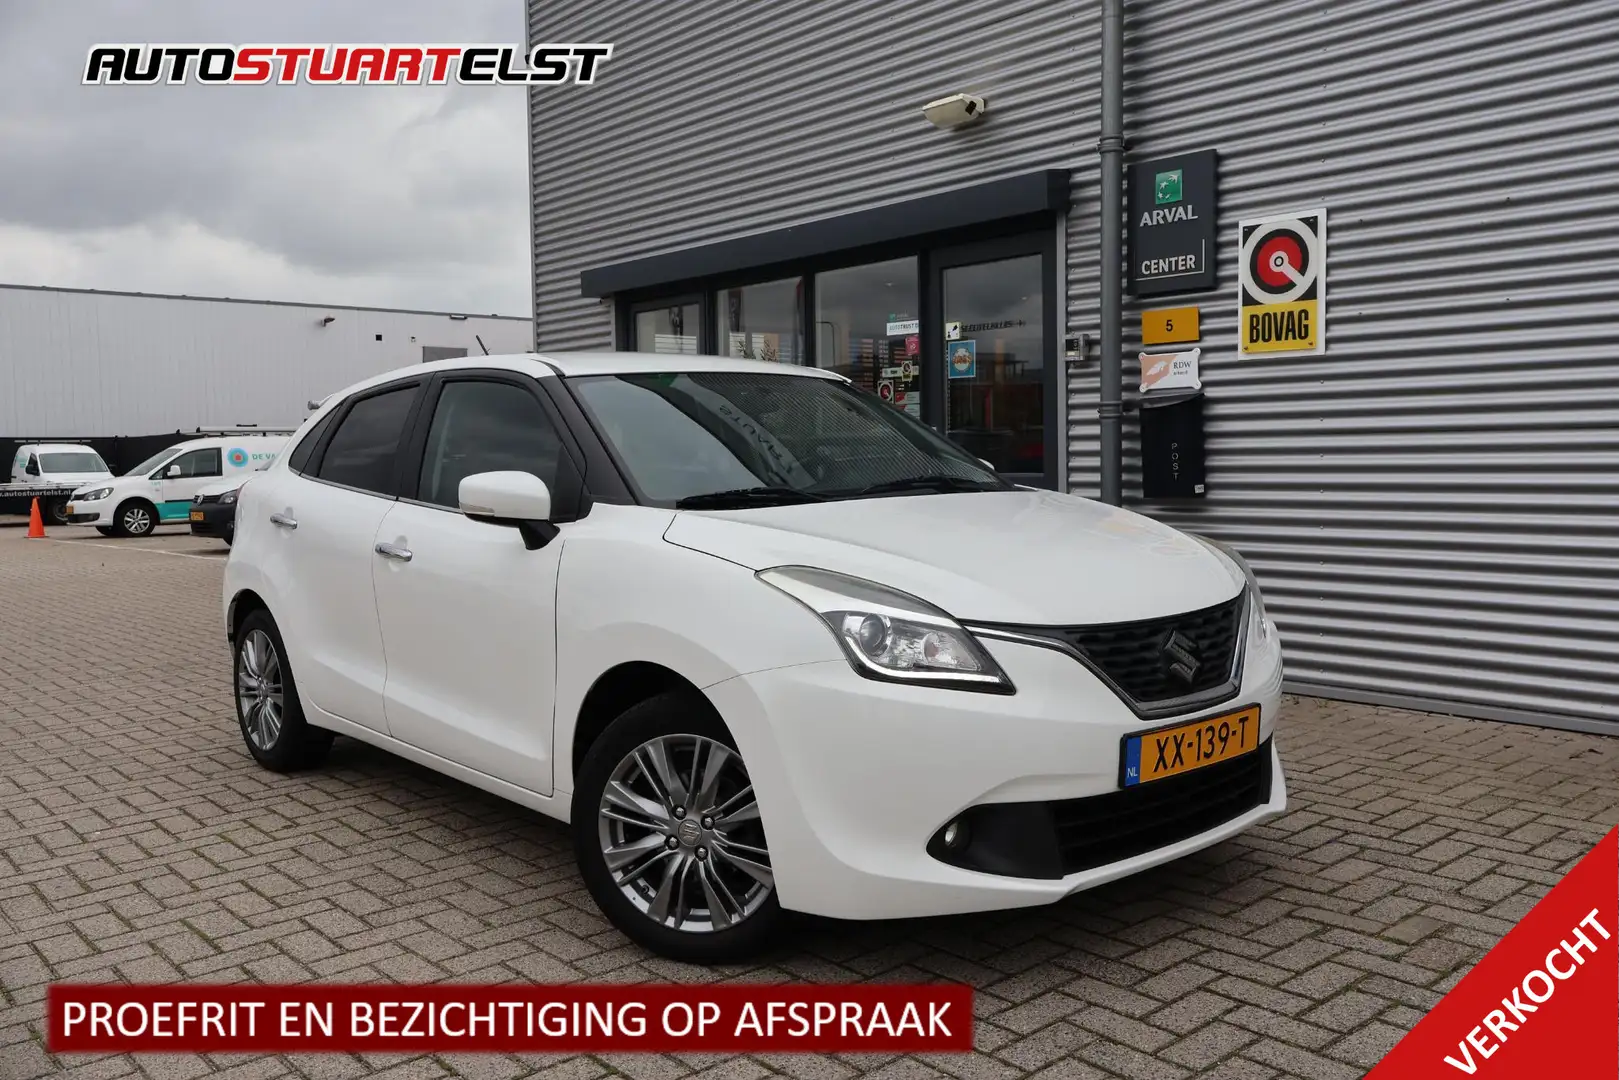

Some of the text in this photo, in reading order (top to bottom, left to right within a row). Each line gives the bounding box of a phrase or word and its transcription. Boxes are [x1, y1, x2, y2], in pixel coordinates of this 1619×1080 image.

[1140, 205, 1198, 227] ARVAL
[1142, 255, 1196, 275] CENTER
[1165, 319, 1174, 332] 5
[1249, 309, 1309, 343] BOVAG
[1173, 361, 1192, 369] RDW
[1171, 442, 1179, 481] POST
[1153, 716, 1249, 772] XX-139-T
[1127, 767, 1138, 778] NL
